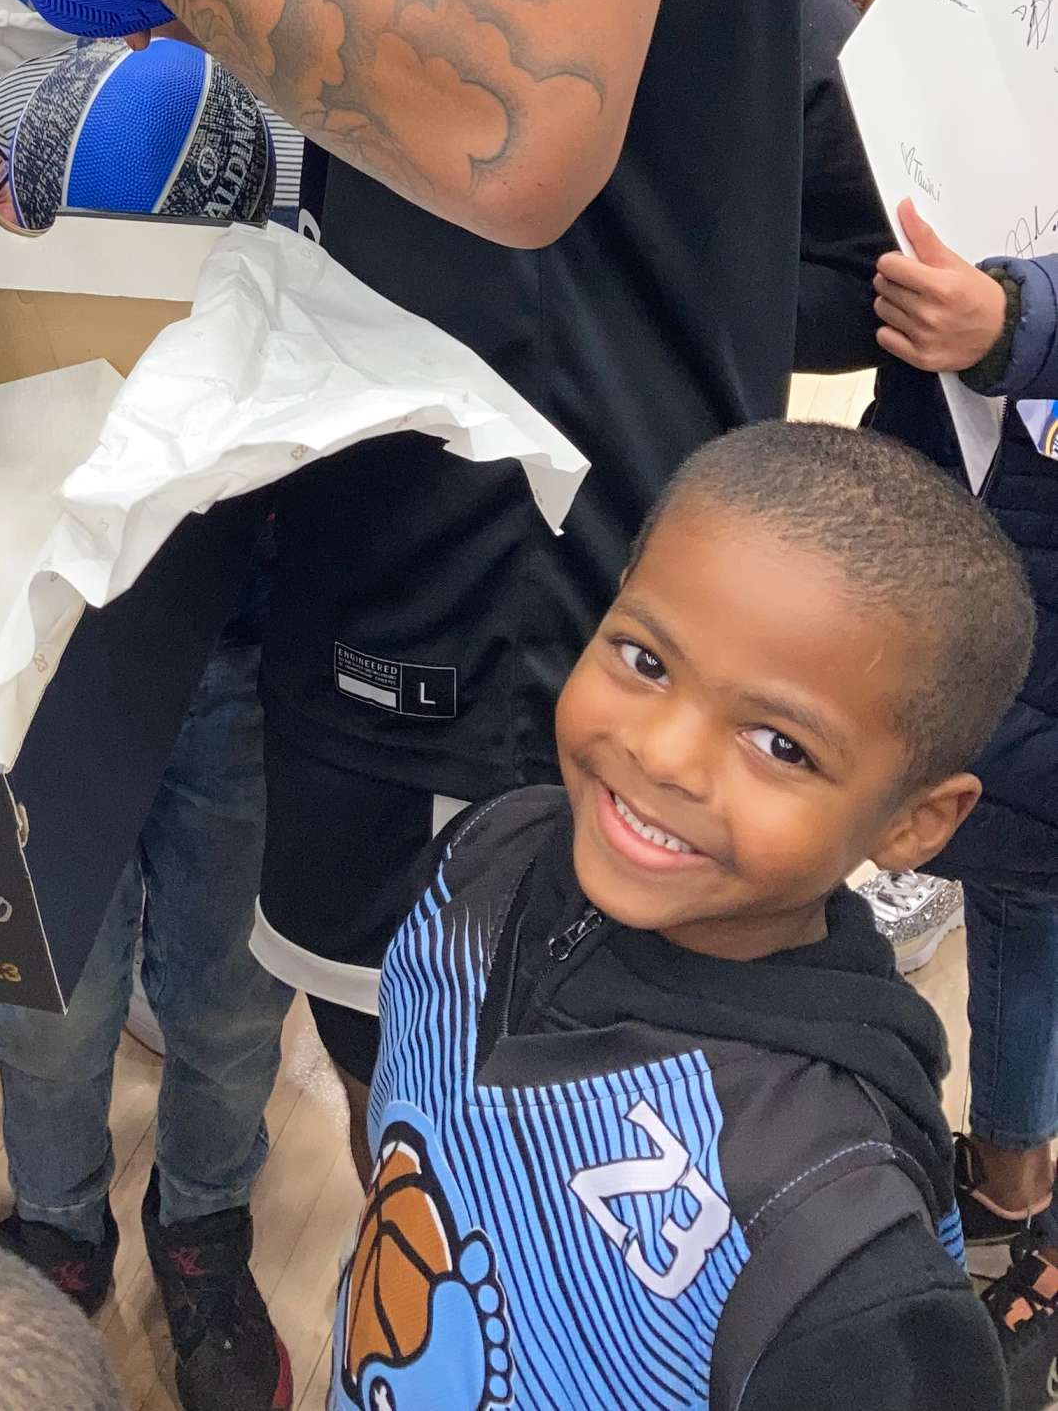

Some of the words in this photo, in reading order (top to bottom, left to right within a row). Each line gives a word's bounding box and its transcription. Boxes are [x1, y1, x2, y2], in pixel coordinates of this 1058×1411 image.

[338, 647, 399, 676] ENGINEERED
[419, 682, 437, 705] L
[567, 1101, 732, 1301] 23
